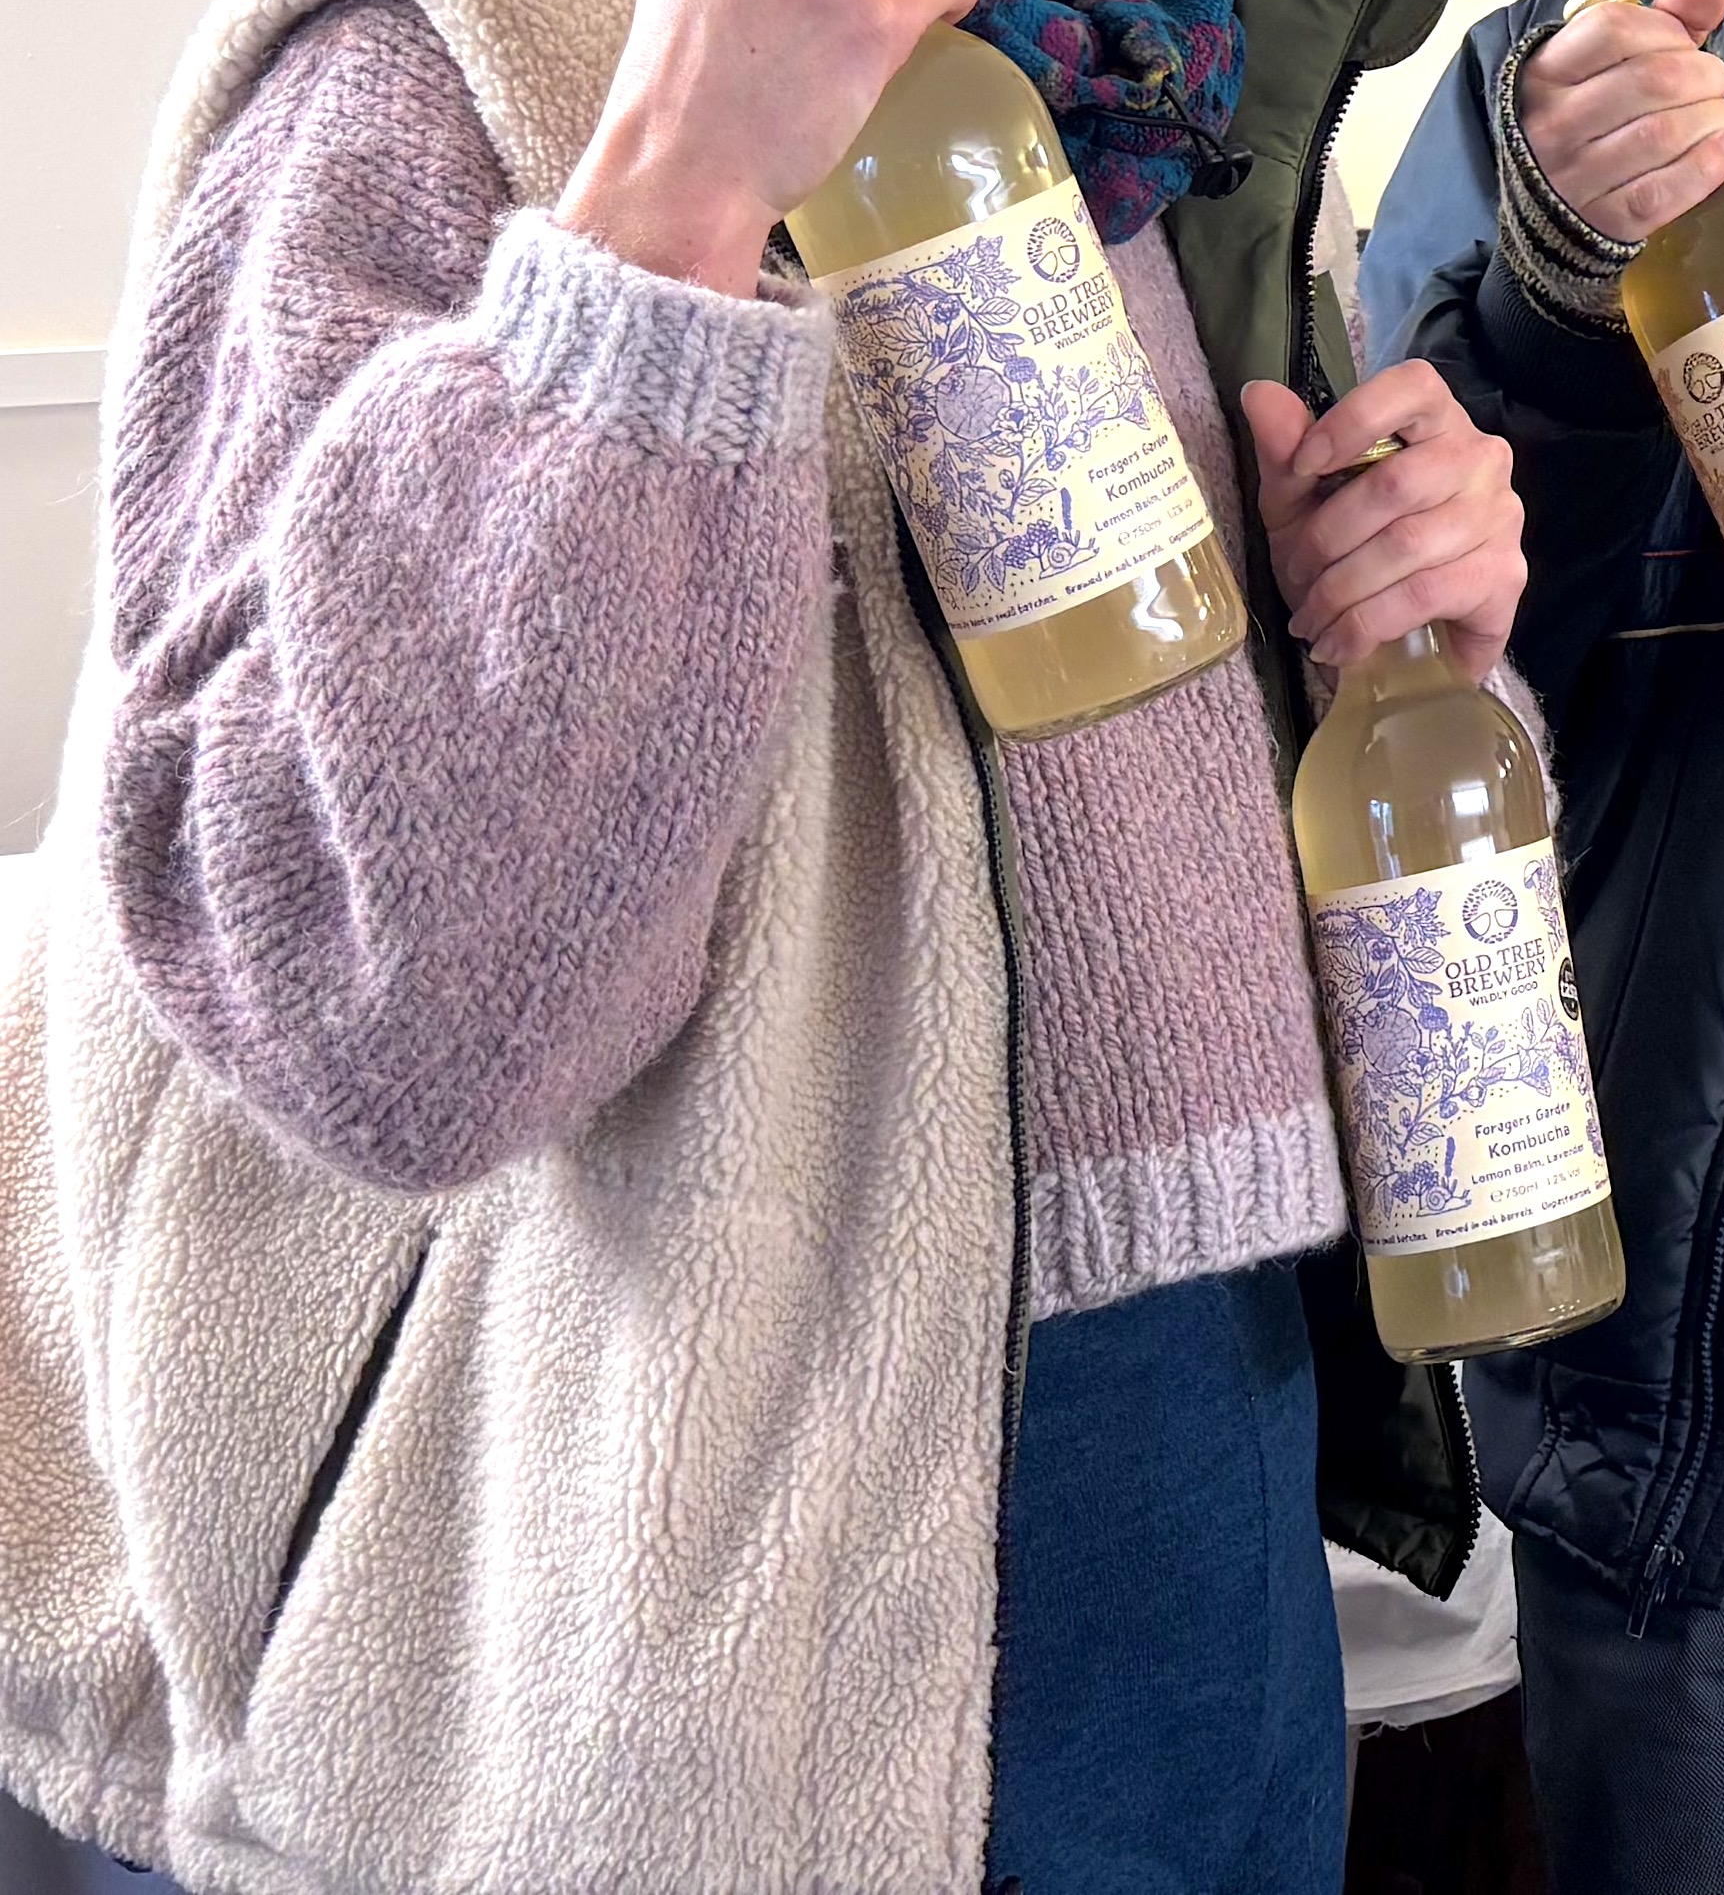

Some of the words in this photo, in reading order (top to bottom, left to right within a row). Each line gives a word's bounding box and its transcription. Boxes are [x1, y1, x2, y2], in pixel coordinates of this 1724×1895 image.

[1022, 293, 1068, 326] OLD
[1028, 289, 1115, 346] BREWERY
[1105, 456, 1175, 502] Kombucha
[1445, 954, 1492, 980] OLD
[1496, 937, 1545, 967] TREE
[1447, 955, 1546, 999] BREWERY
[1469, 989, 1508, 1007] WILDLY
[1510, 980, 1539, 996] GOOD
[1474, 1114, 1531, 1139] Foragers
[1535, 1102, 1571, 1122] Garden
[1488, 1124, 1571, 1159] Kombucha
[1471, 1168, 1512, 1185] Lemon
